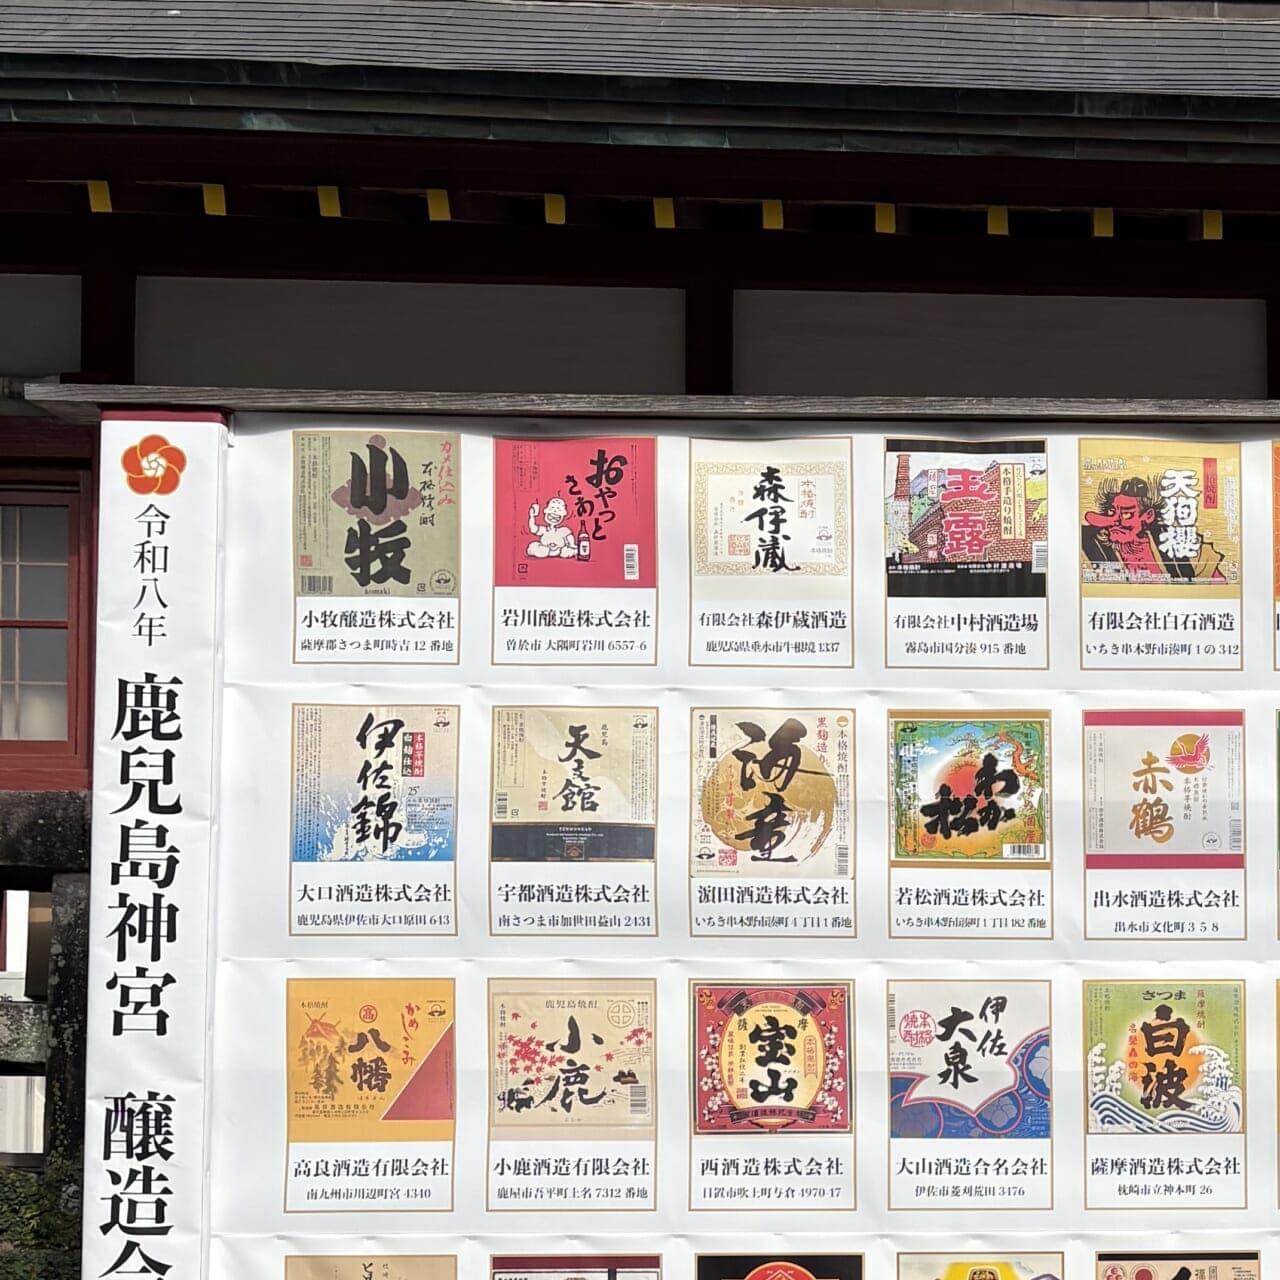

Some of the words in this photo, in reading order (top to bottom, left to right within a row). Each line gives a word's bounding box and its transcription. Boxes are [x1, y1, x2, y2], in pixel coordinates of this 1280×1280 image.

[345, 443, 412, 586] 小牧
[742, 466, 800, 572] 森伊蔵
[942, 468, 997, 557] 玉露
[131, 504, 171, 647] 令和八年
[302, 610, 455, 629] 小牧醸造株式会社
[501, 609, 650, 628] 岩川醸造株式会社
[699, 610, 847, 629] 有限会社森伊蔵酒造
[894, 613, 1038, 632] 有限会社中村酒造場
[1088, 612, 1235, 631] 有限会社白石酒造
[351, 712, 404, 852] 伊佐錦
[1129, 752, 1174, 844] 赤鶴
[297, 884, 451, 902] 大口酒造株式会社
[498, 884, 650, 903] 宇都酒造株式会社
[896, 887, 1045, 907] 若松酒造株式会社
[1094, 890, 1239, 908] 出水酒造株式会社
[545, 999, 598, 1009] 鹿児島焼酎
[1142, 990, 1187, 1002] さつま
[349, 1028, 392, 1092] 八幡
[534, 1016, 606, 1113] 小鹿
[748, 1016, 797, 1103] 宝山
[1141, 1004, 1198, 1110] 白波
[494, 1158, 650, 1176] 小鹿酒造有限会社
[701, 1157, 843, 1176] 西酒造株式会社
[896, 1157, 1047, 1176] 大山酒造合名会社
[1092, 1157, 1240, 1175] 薩摩酒造株式会社
